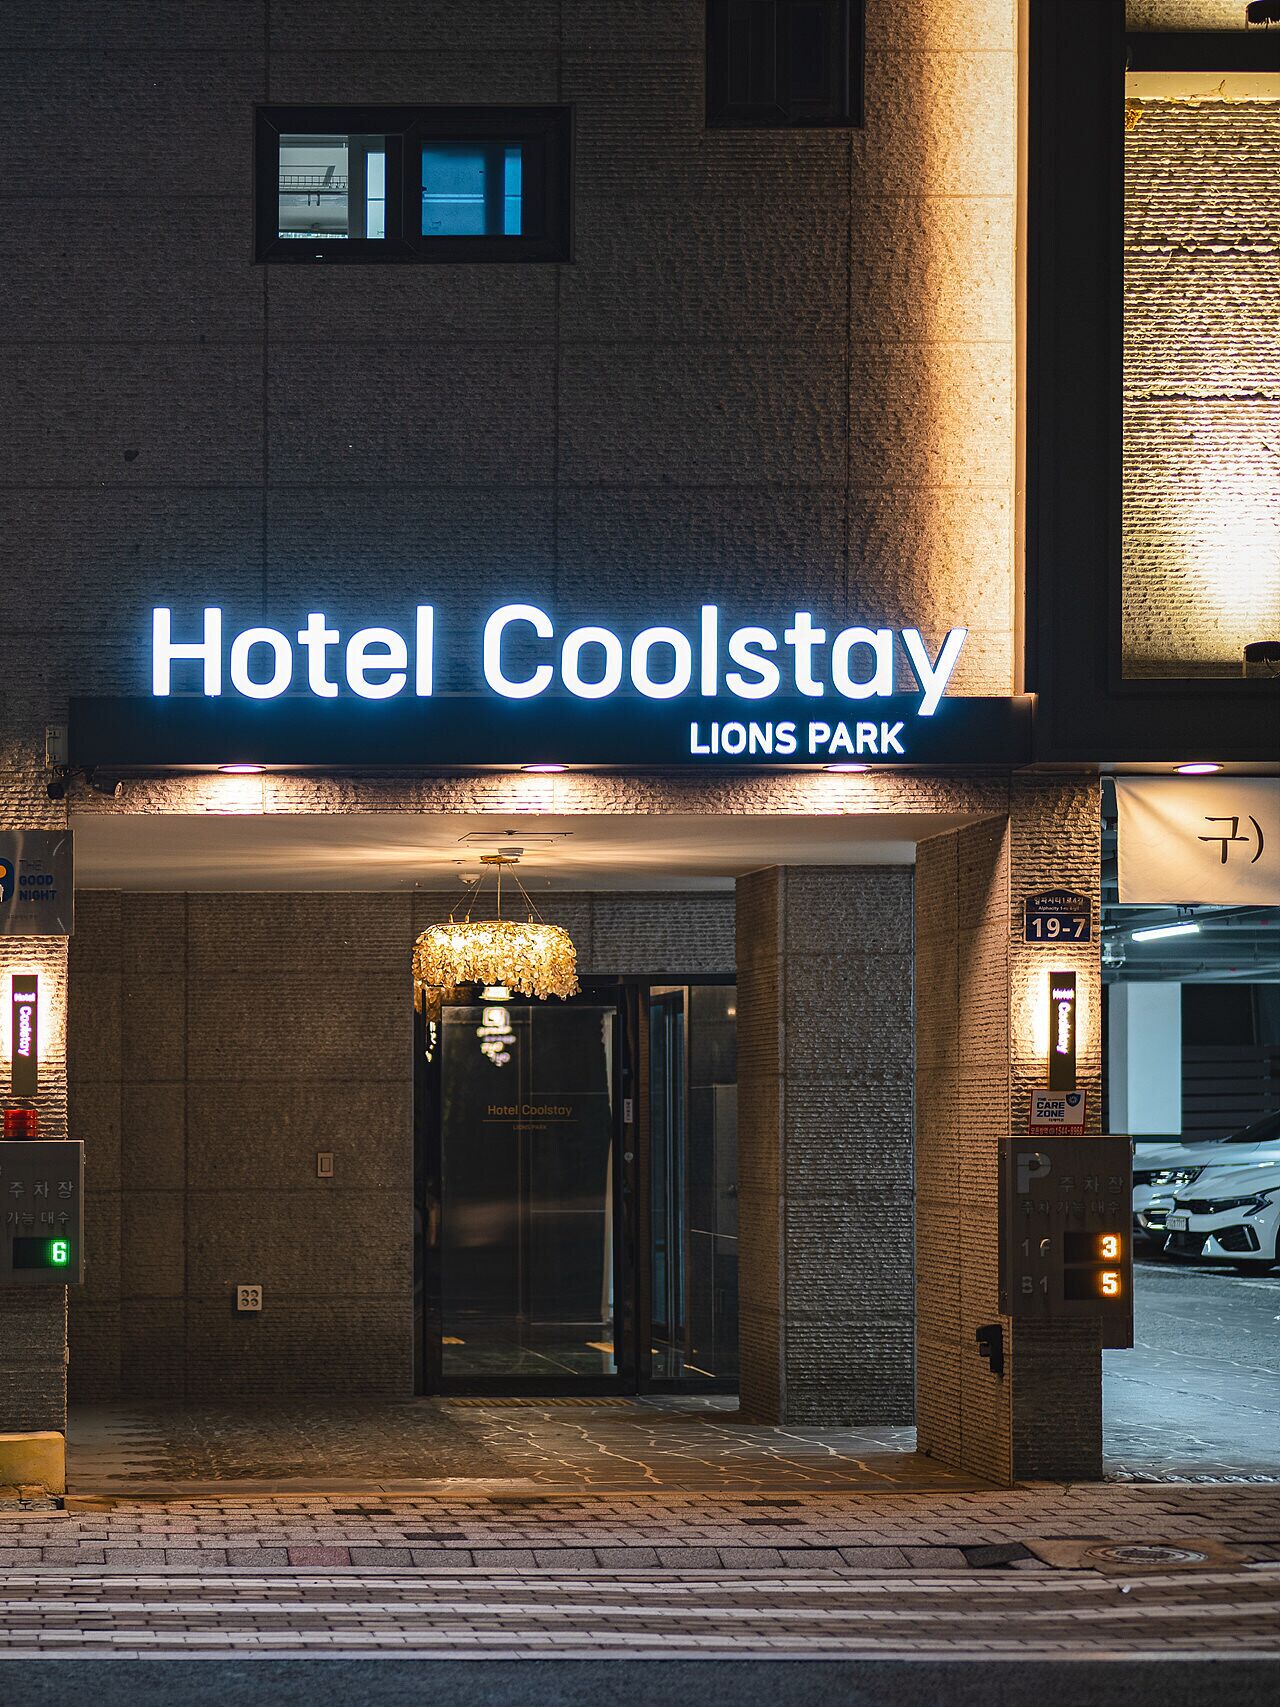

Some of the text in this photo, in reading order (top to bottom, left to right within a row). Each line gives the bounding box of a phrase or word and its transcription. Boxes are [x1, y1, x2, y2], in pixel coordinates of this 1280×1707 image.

[151, 603, 970, 717] Hotel Coolstay
[689, 721, 906, 755] LIONS PARK
[1197, 815, 1265, 864] 구)
[18, 859, 43, 872] THE
[19, 874, 54, 886] GOOD
[19, 889, 57, 901] NIGHT
[1032, 917, 1086, 938] 19-7
[17, 1004, 32, 1057] Coolstay
[487, 1104, 573, 1117] Hotel Coolstay
[1036, 1101, 1066, 1109] CARE
[1036, 1109, 1065, 1117] ZONE
[1016, 1152, 1052, 1194] P
[52, 1241, 67, 1262] 6
[1101, 1235, 1117, 1258] 3
[1101, 1272, 1118, 1295] 5
